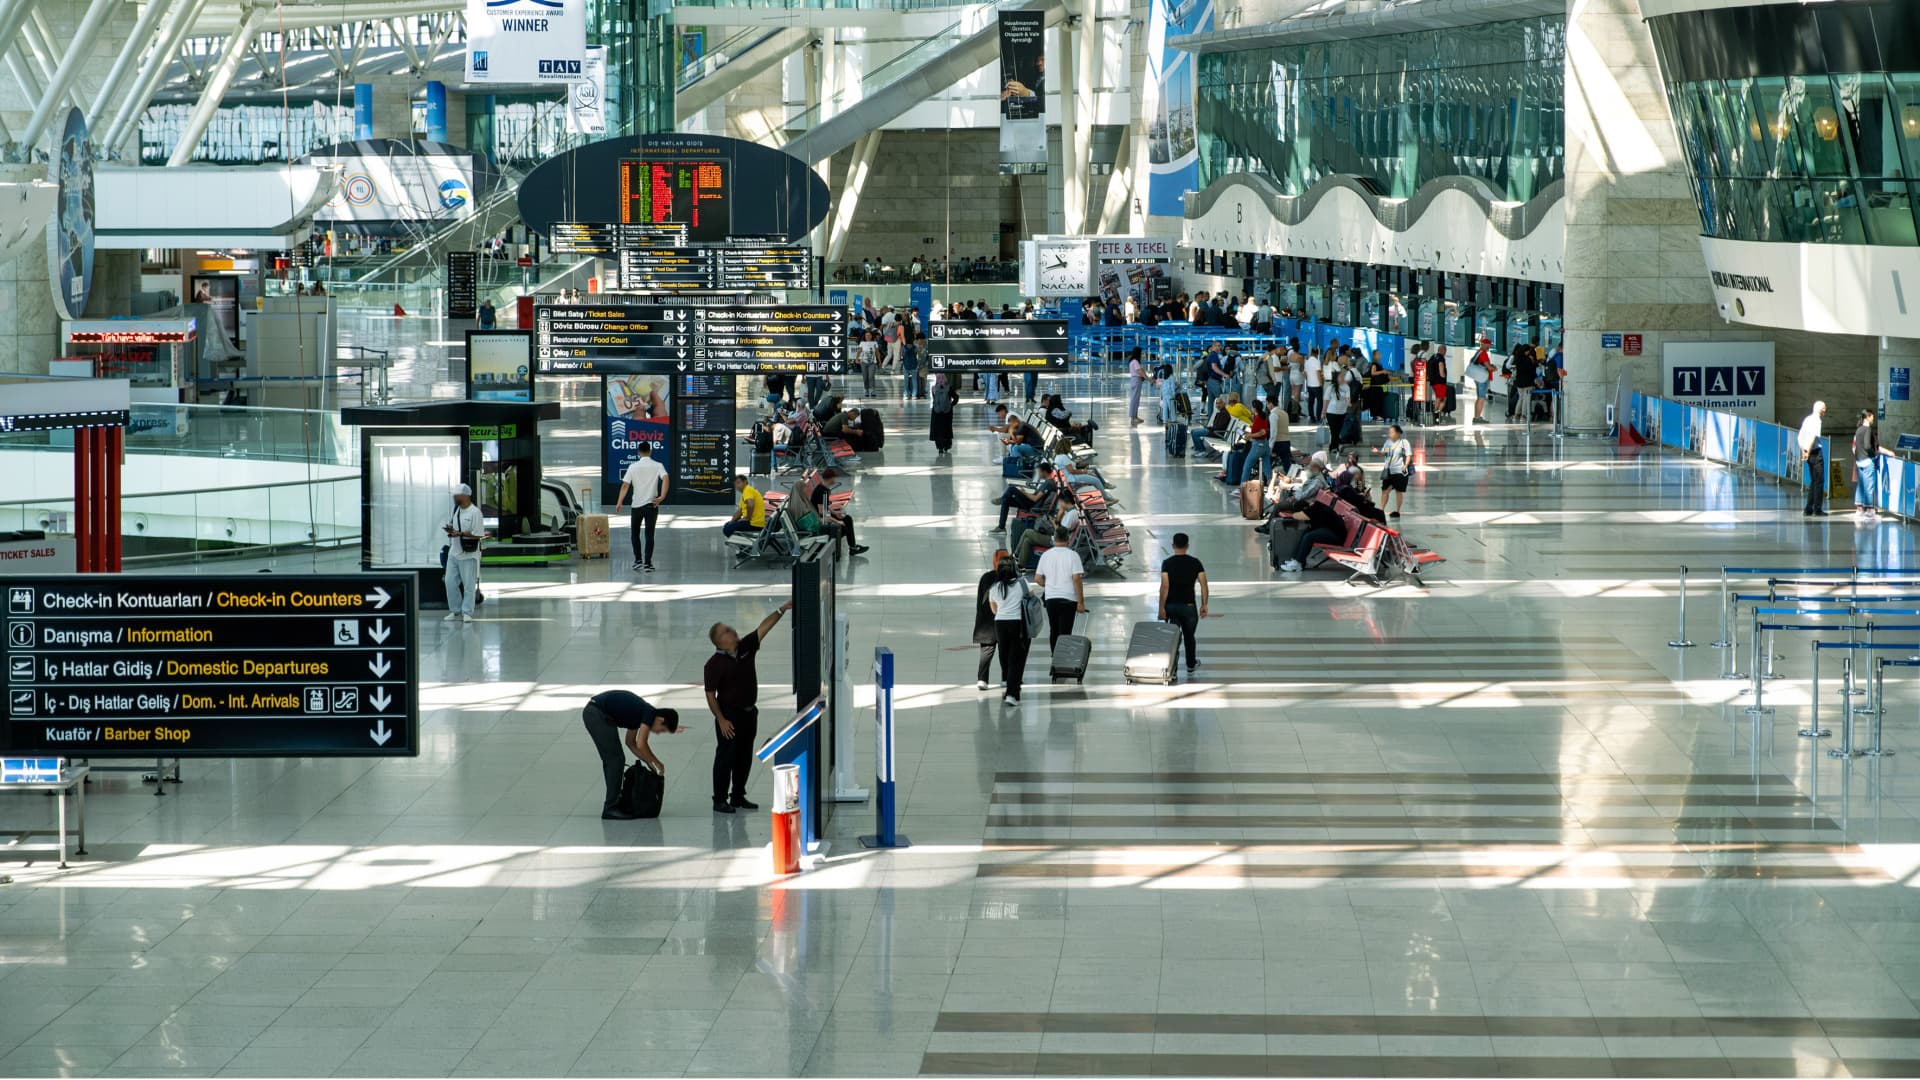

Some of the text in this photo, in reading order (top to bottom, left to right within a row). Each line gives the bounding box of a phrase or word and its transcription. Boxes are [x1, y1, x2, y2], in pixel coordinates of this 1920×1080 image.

[503, 19, 549, 32] WINNER
[539, 60, 581, 73] TAV
[1124, 242, 1132, 254] &
[1137, 243, 1168, 254] TEKEL
[568, 311, 584, 319] Satış
[553, 336, 589, 344] Restoranlar
[594, 336, 609, 344] Food
[611, 336, 628, 344] Court
[708, 338, 735, 346] Danışma
[553, 349, 569, 358] Çıkış
[735, 350, 750, 359] Gidiş
[785, 351, 819, 359] Departures
[553, 361, 579, 369] Asansör
[976, 358, 997, 366] Kontrol
[1026, 358, 1047, 366] Control
[1673, 367, 1765, 396] TAV
[629, 430, 664, 441] Döviz
[0, 548, 55, 559] TICKET SALES
[43, 592, 112, 609] Check-in
[118, 591, 202, 608] Kontuarları
[217, 592, 286, 607] Check-in
[291, 592, 362, 607] Counters
[43, 628, 113, 648] Danışma
[127, 627, 212, 643] Information
[45, 659, 58, 681] İç
[62, 661, 109, 677] Hatlar
[113, 660, 153, 681] Gidiş
[167, 660, 238, 676] Domestic
[243, 660, 329, 680] Departures
[45, 692, 58, 714] İç
[69, 695, 91, 714] Dış
[94, 695, 134, 712] Hatlar
[137, 694, 170, 712] Geliş
[182, 694, 216, 710] Dom.
[228, 694, 248, 709] Int.
[251, 693, 299, 709] Arrivals
[46, 726, 92, 741] Kuaför
[104, 727, 150, 741] Barber
[154, 727, 190, 743] Shop
